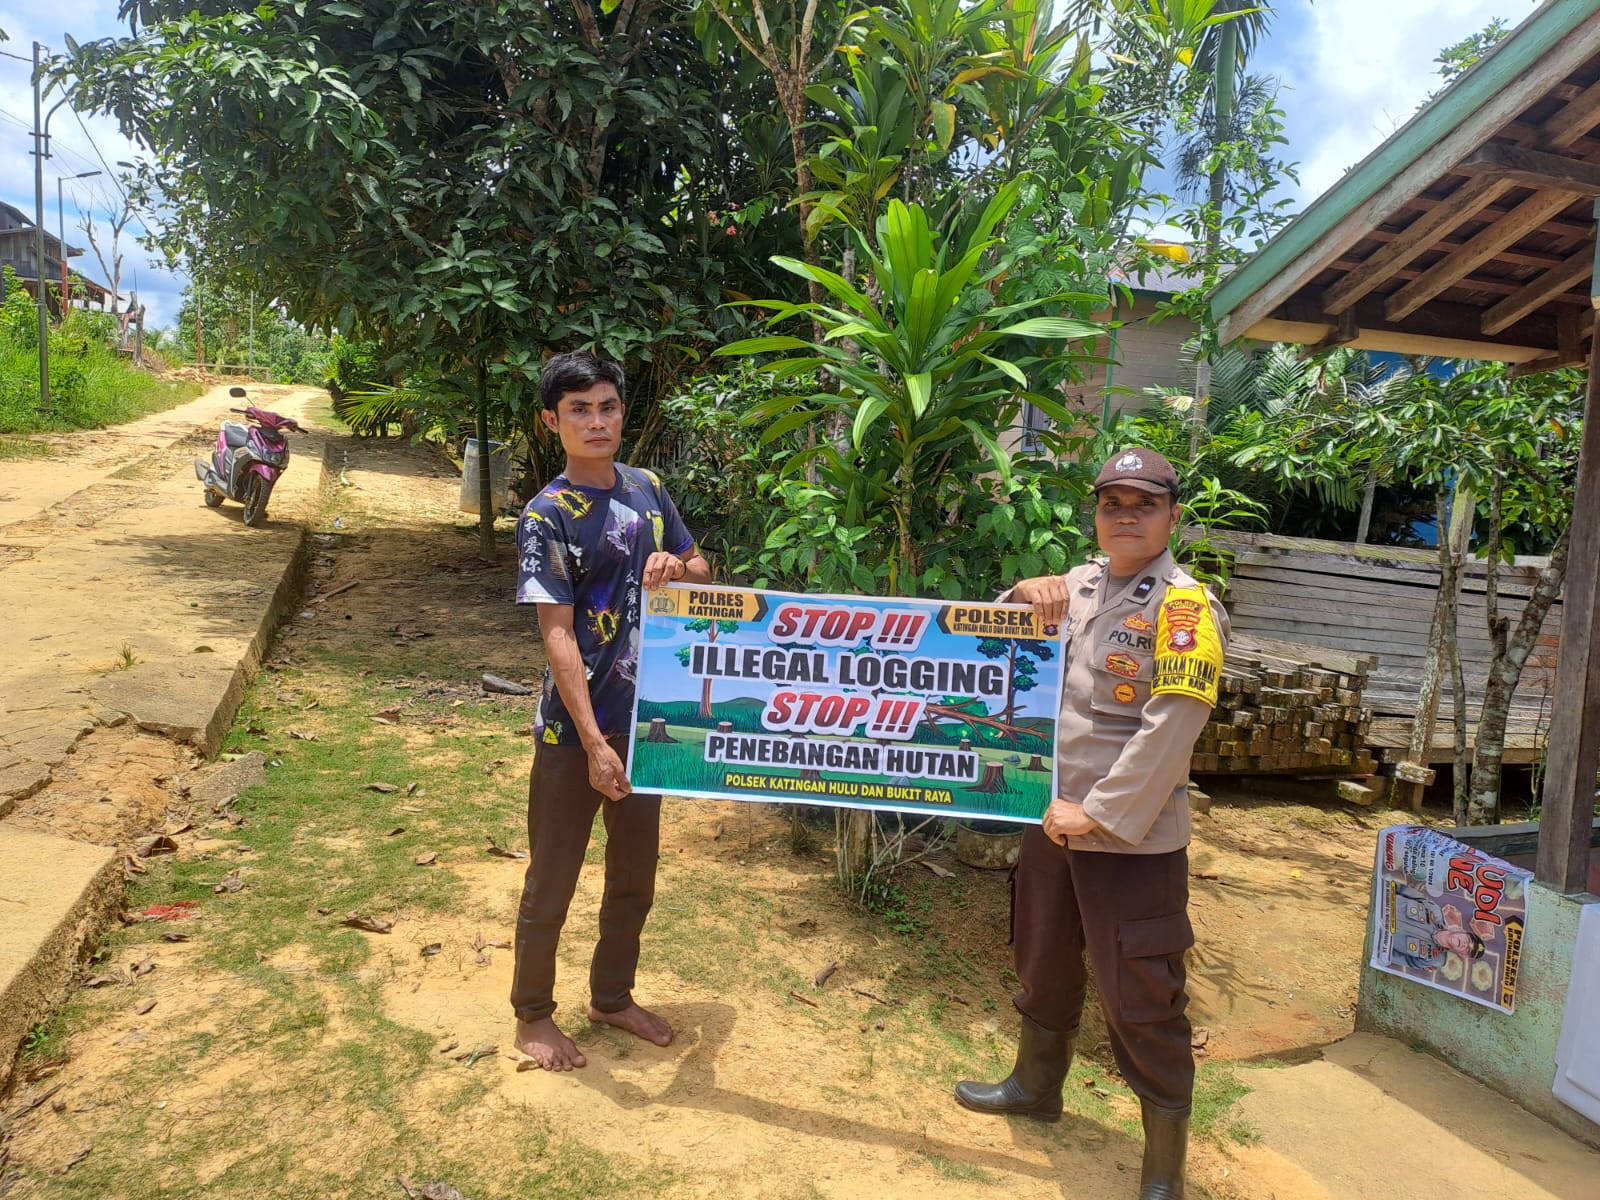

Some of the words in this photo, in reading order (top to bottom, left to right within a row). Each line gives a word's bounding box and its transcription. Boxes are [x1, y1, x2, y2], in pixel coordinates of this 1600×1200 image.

[688, 605, 743, 618] KATINGAN
[689, 590, 744, 607] POLRES
[773, 607, 876, 641] STOP
[877, 614, 925, 644] !!!
[954, 608, 1034, 627] POLSEK
[1109, 630, 1152, 650] POLRI
[692, 645, 829, 683] ILLEGAL
[839, 655, 1004, 696] LOGGING
[767, 692, 870, 728] STOP
[872, 700, 920, 733] !!!
[708, 736, 879, 770] PENEBANGAN
[886, 749, 975, 778] HUTAN
[726, 774, 766, 788] POLSEK
[769, 777, 826, 793] KATINGAN
[828, 783, 858, 795] HULU
[861, 785, 883, 798] DAN
[886, 787, 922, 801] BUKIT
[925, 790, 952, 803] RAYA
[1508, 929, 1522, 987] POLSEK
